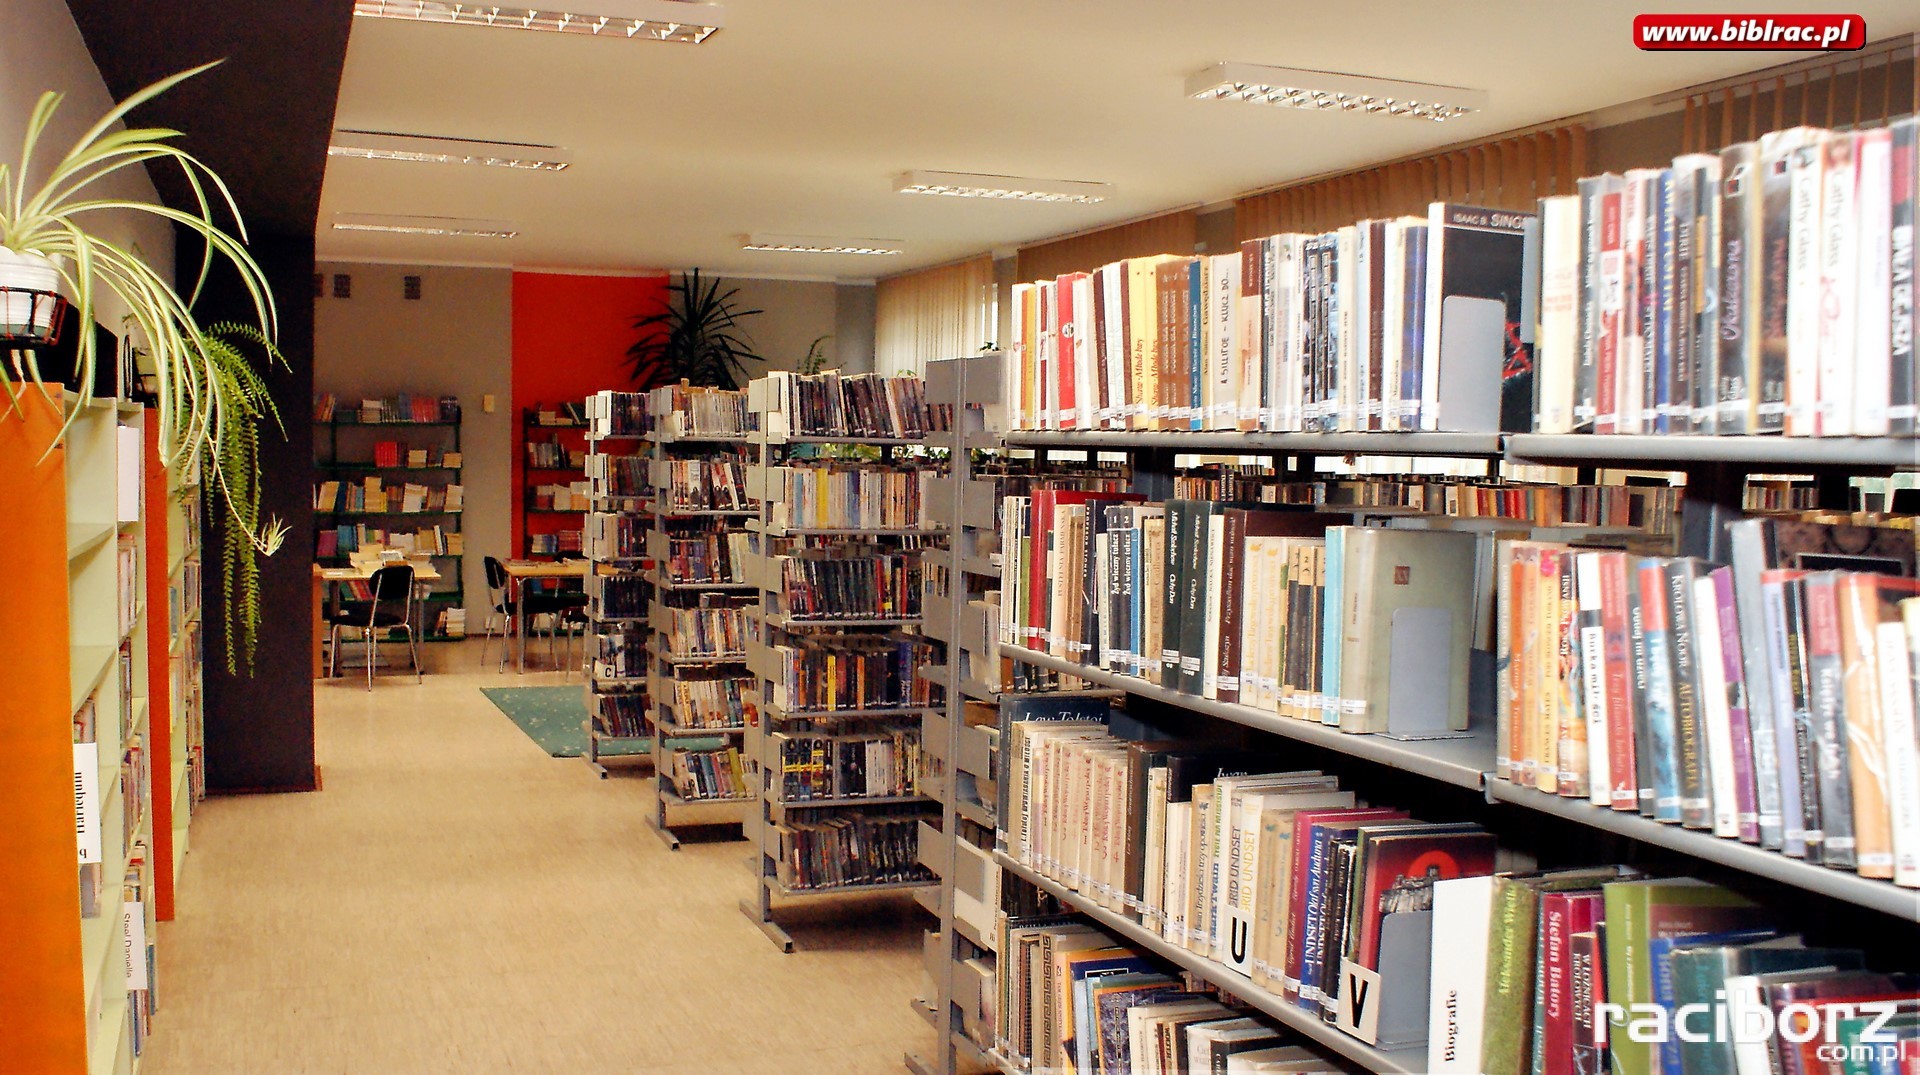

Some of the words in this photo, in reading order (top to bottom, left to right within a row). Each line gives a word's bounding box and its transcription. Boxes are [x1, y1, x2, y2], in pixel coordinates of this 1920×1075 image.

[1453, 213, 1479, 226] ISAAC
[1490, 213, 1524, 230] SING
[1796, 228, 1810, 271] Glass
[1828, 224, 1844, 268] Glass
[1220, 295, 1229, 322] KLUCZ
[1220, 336, 1229, 375] SILLITOE
[1123, 515, 1130, 524] 2
[1110, 533, 1119, 555] tułacz
[1111, 556, 1120, 581] wieczny
[1168, 591, 1176, 604] Don
[1588, 633, 1599, 671] Burka
[1676, 632, 1690, 668] NOOR
[604, 667, 612, 678] C
[1025, 711, 1054, 721] Lew
[1678, 681, 1699, 789] AUTOBIOGRAFIA
[74, 771, 87, 834] Harlequin
[1230, 825, 1242, 878] UNDSET
[1243, 830, 1255, 882] UNDSET
[1311, 839, 1323, 880] Auduna
[1209, 862, 1219, 903] Twain
[1309, 879, 1319, 893] syn
[1208, 905, 1218, 938] Mark
[1305, 893, 1318, 914] Olaf
[1231, 915, 1248, 965] U
[1304, 912, 1317, 965] UNDSET
[1549, 911, 1562, 962] Stefan
[1498, 927, 1513, 996] Aleksander
[1582, 953, 1591, 965] W
[1349, 972, 1370, 1029] V
[1548, 966, 1563, 1020] Batory
[1572, 952, 1583, 1021] KRÓLOWYCH
[1444, 989, 1458, 1063] Biografie
